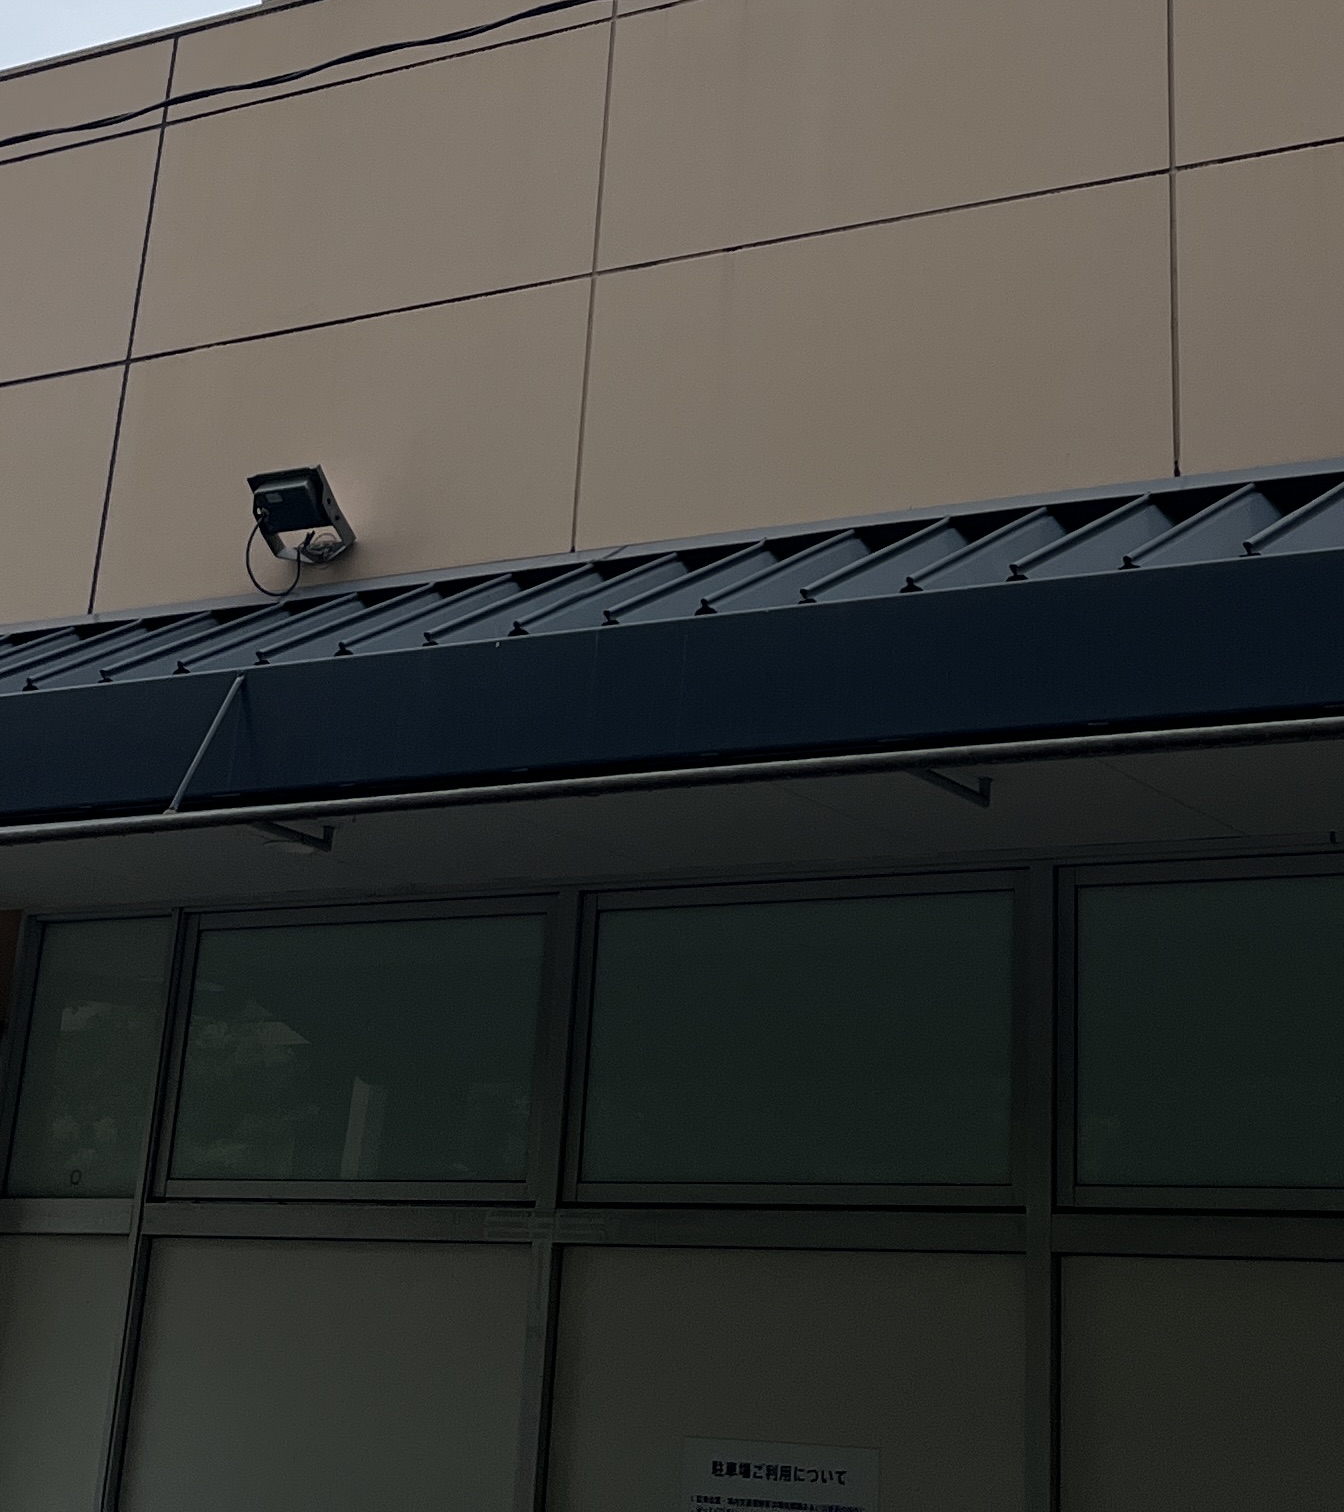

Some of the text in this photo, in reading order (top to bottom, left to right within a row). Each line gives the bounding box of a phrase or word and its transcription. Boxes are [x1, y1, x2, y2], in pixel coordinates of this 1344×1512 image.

[711, 1460, 847, 1485] 駐車場ご利用について
